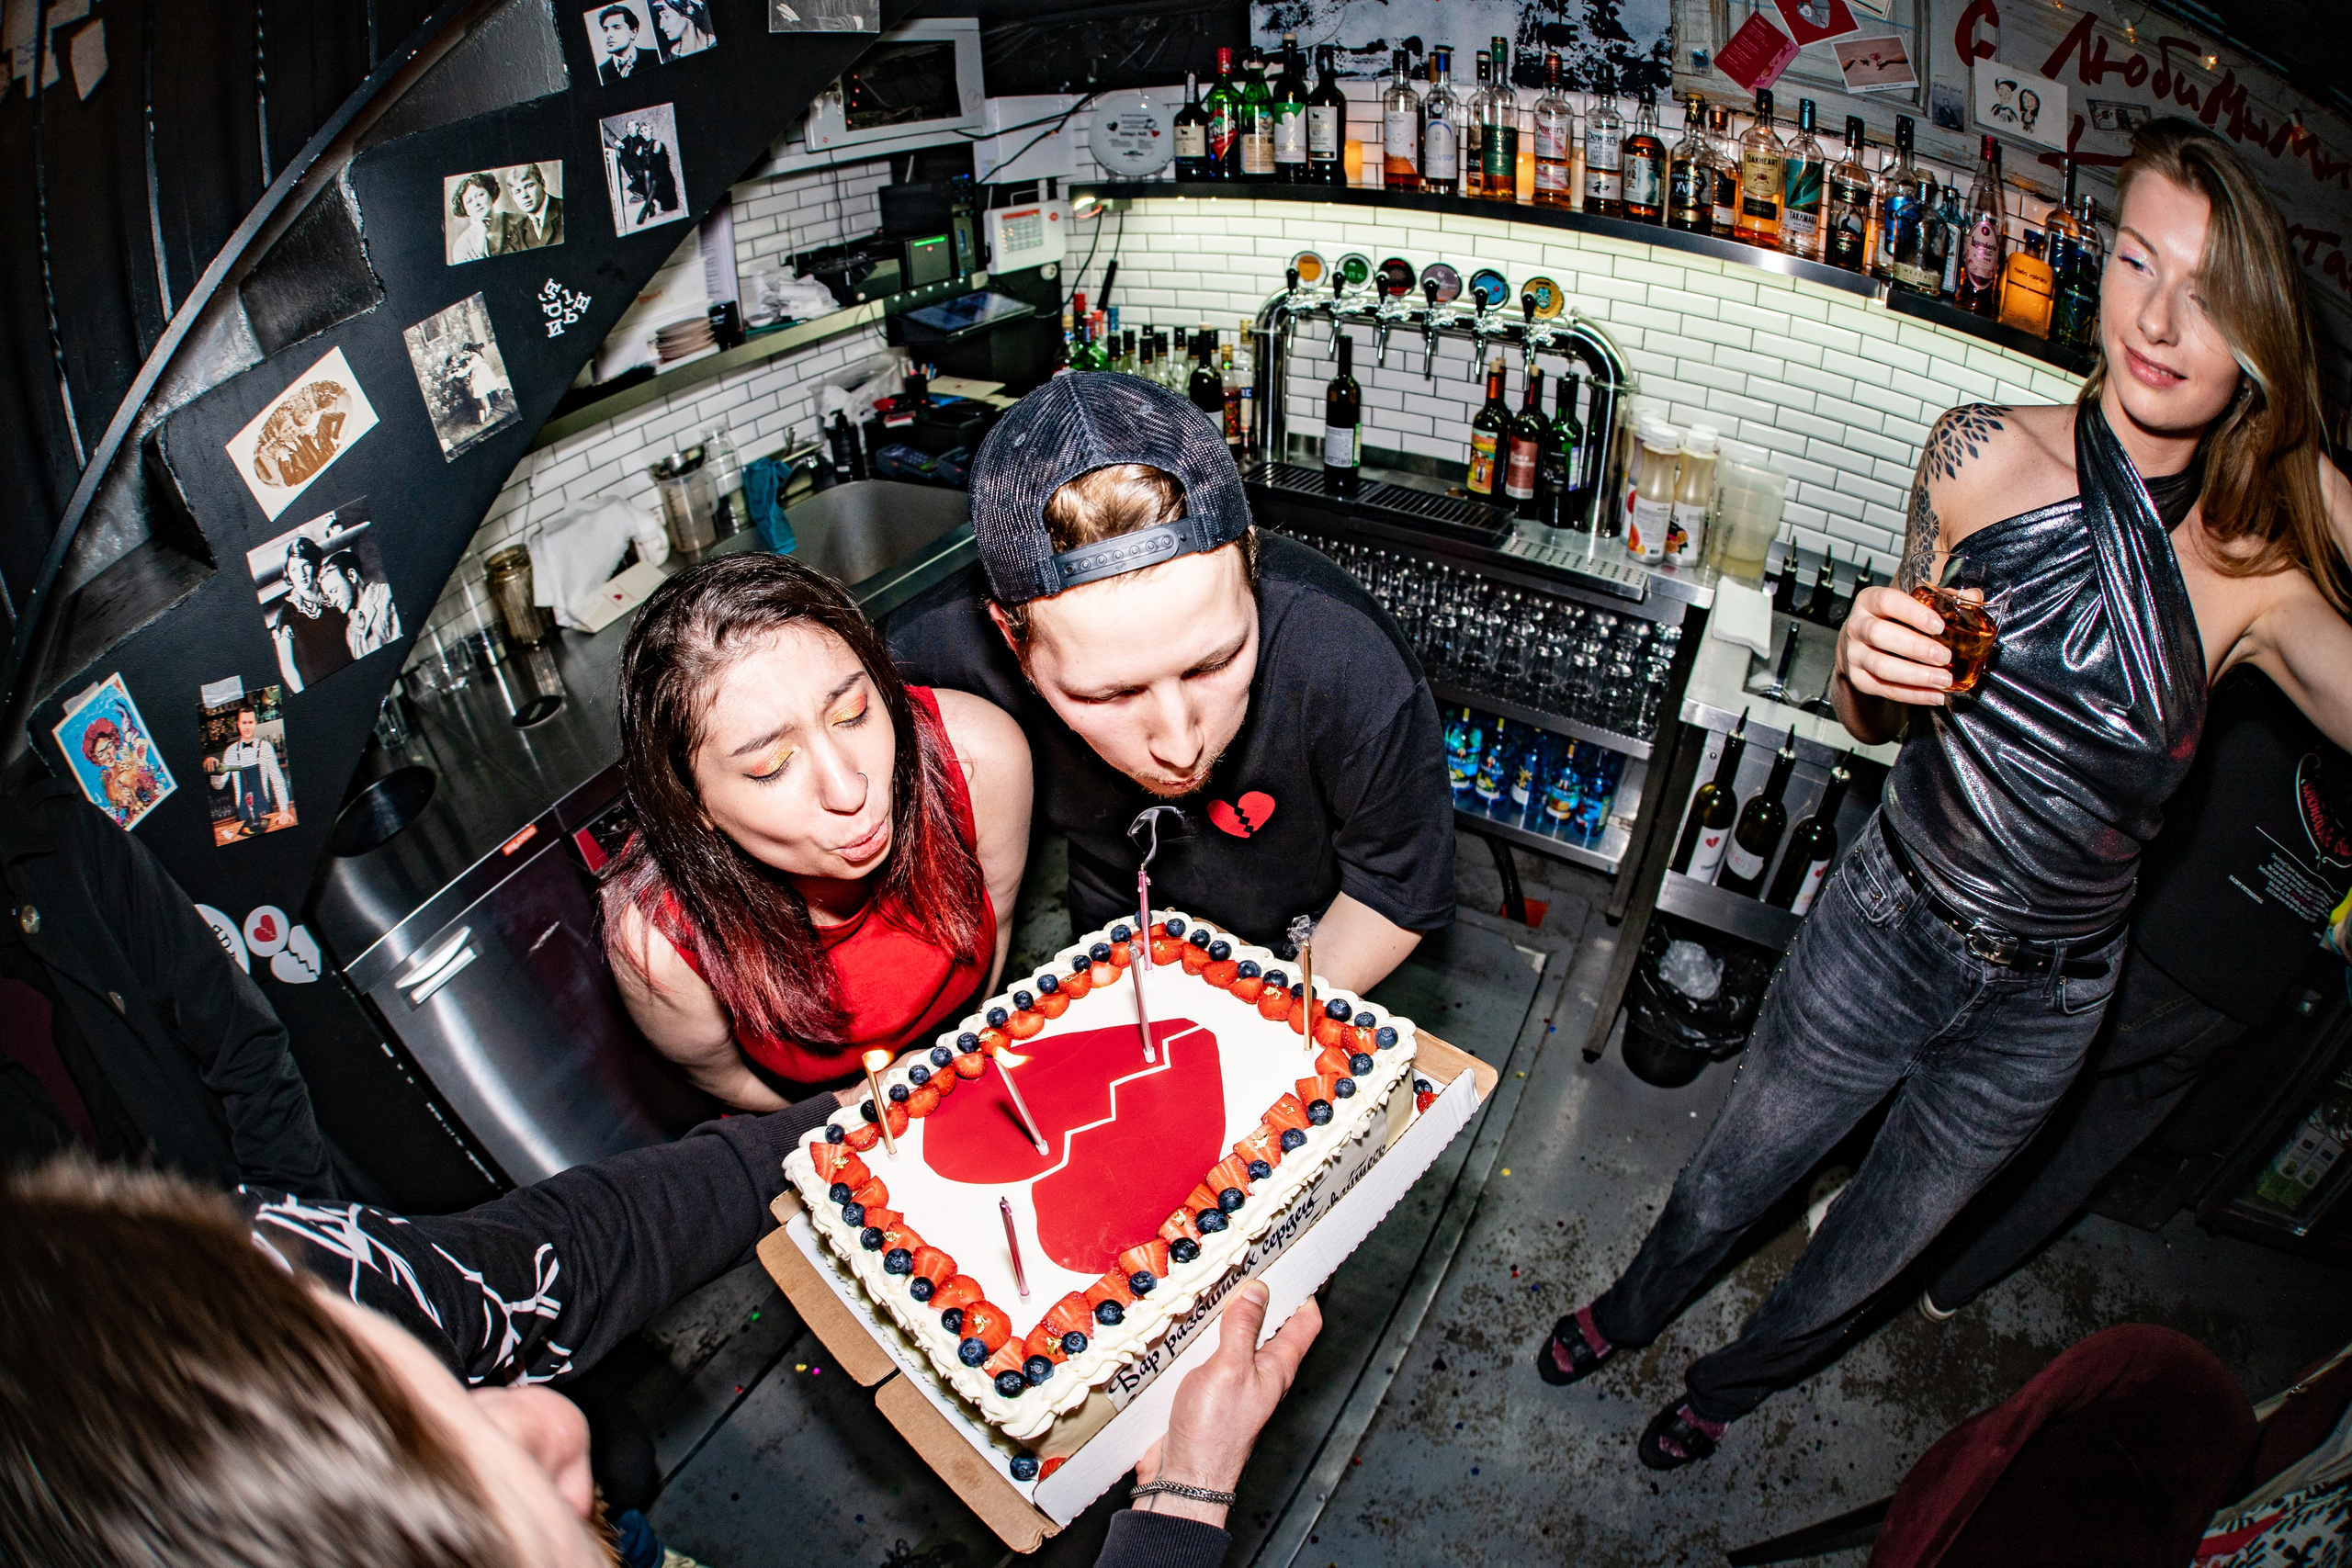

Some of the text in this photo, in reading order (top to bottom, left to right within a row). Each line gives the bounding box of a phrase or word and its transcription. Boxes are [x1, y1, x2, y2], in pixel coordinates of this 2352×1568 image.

[1108, 1174, 1329, 1394] Бар разбитых сердец
